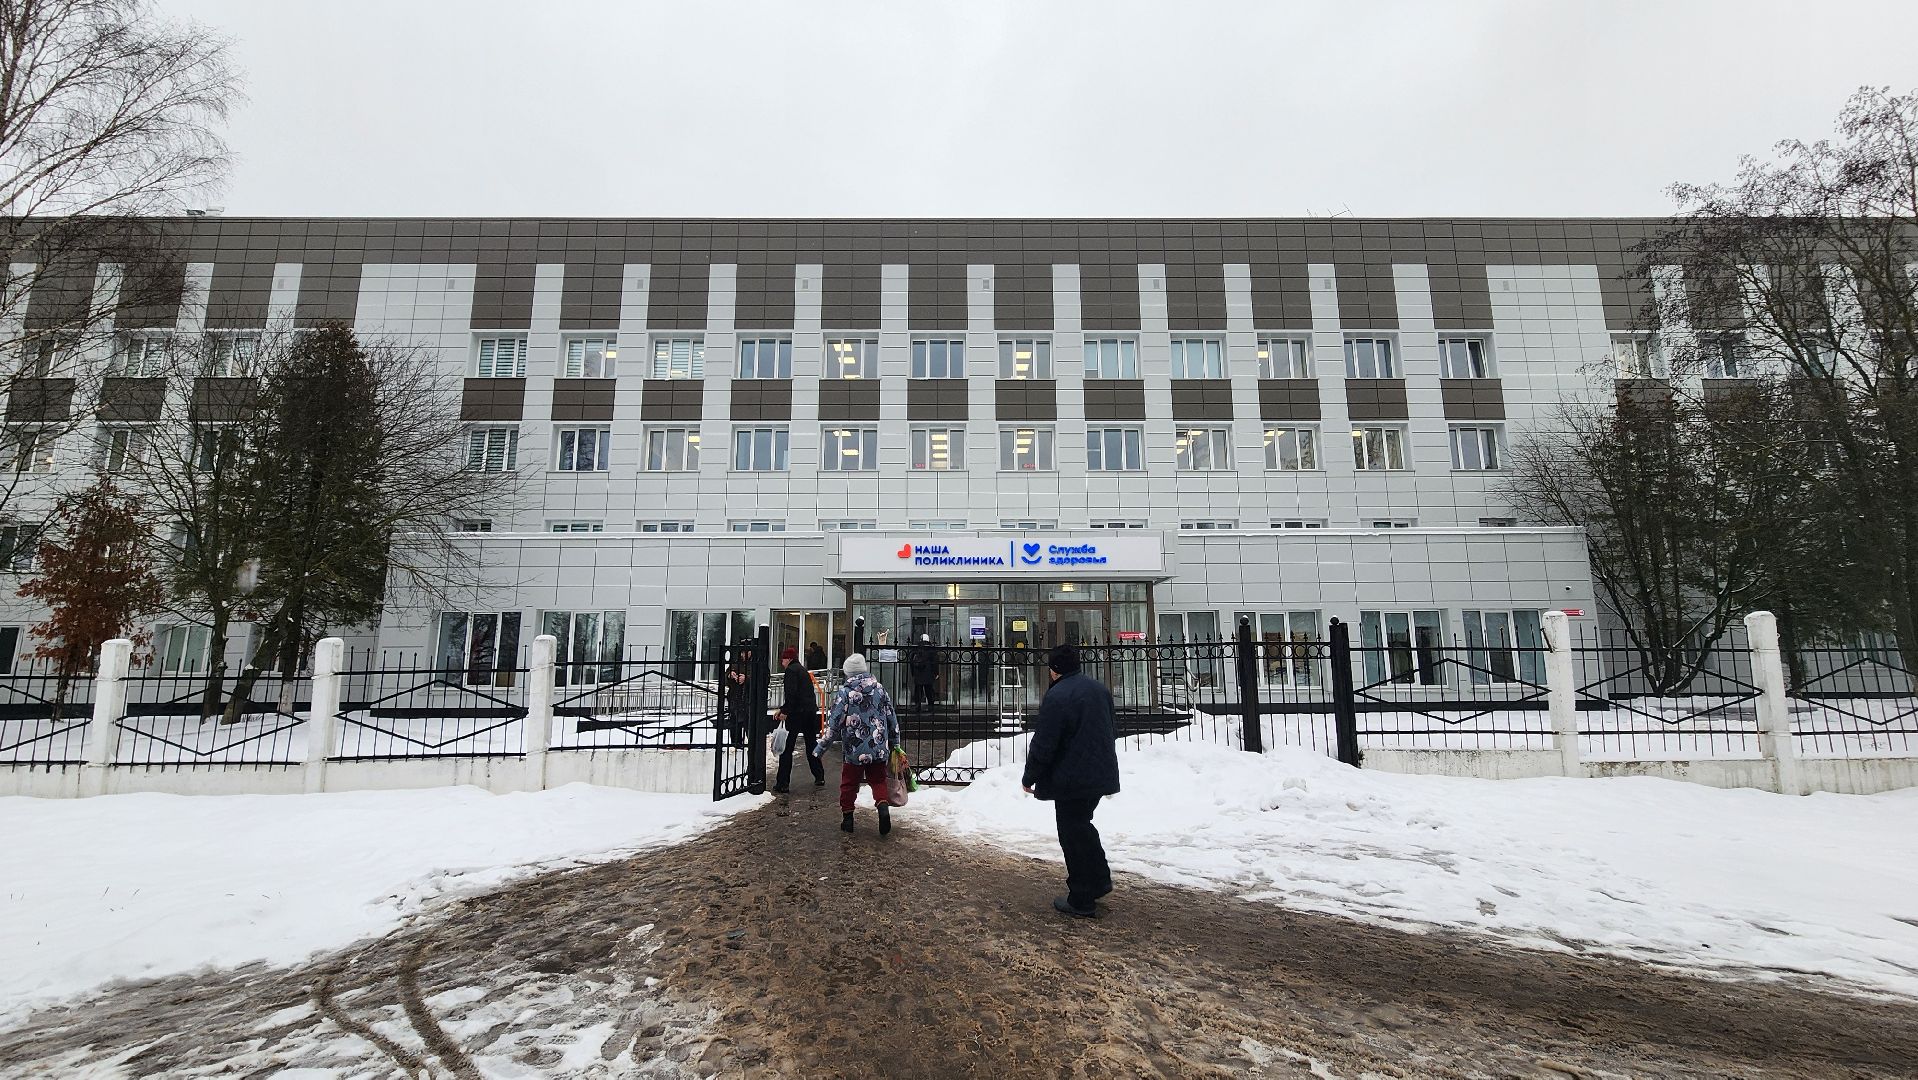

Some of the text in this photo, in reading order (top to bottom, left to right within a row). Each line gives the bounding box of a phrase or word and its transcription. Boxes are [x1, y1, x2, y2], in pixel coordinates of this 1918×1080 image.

[915, 545, 950, 555] НАША
[1048, 543, 1097, 556] Служба
[914, 556, 1004, 566] ПОЛИКЛИНИКА
[1048, 556, 1108, 566] здоровья
